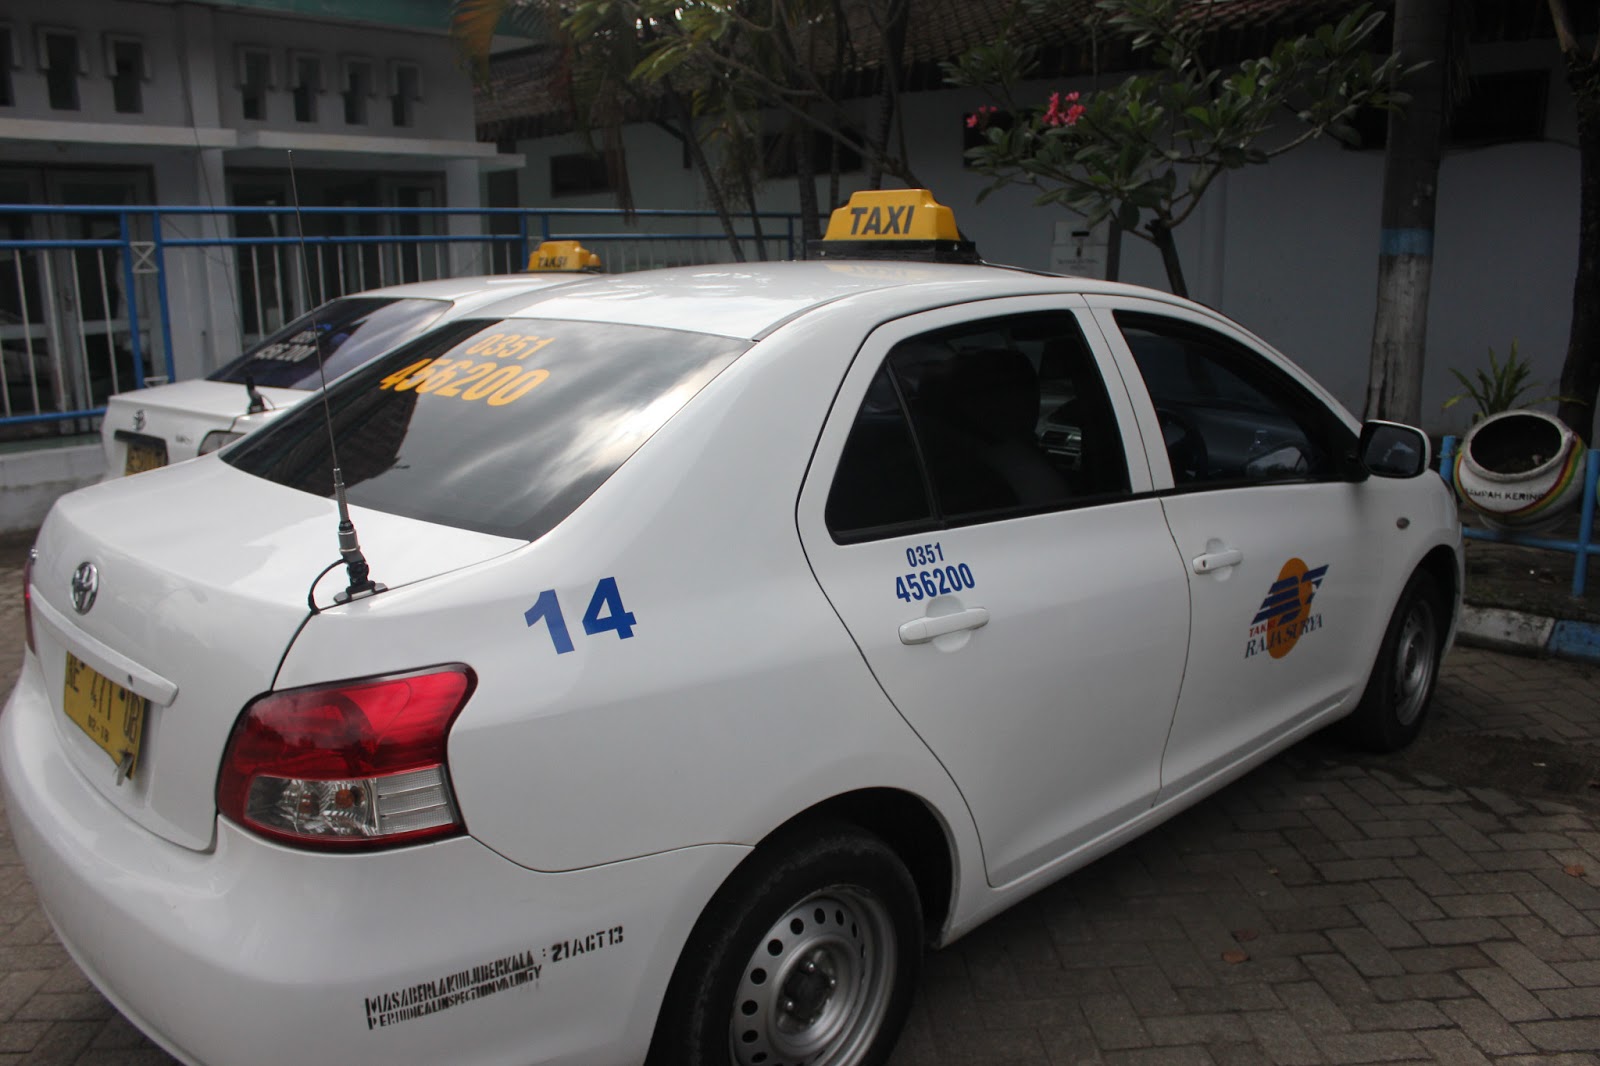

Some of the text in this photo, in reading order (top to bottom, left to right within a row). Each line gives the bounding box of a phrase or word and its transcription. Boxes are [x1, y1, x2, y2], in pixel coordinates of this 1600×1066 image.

[850, 205, 915, 236] TAXI
[465, 333, 556, 360] 0351
[379, 358, 550, 406] 456200
[906, 542, 944, 567] 0351
[896, 563, 975, 603] 456200
[524, 577, 637, 655] 14
